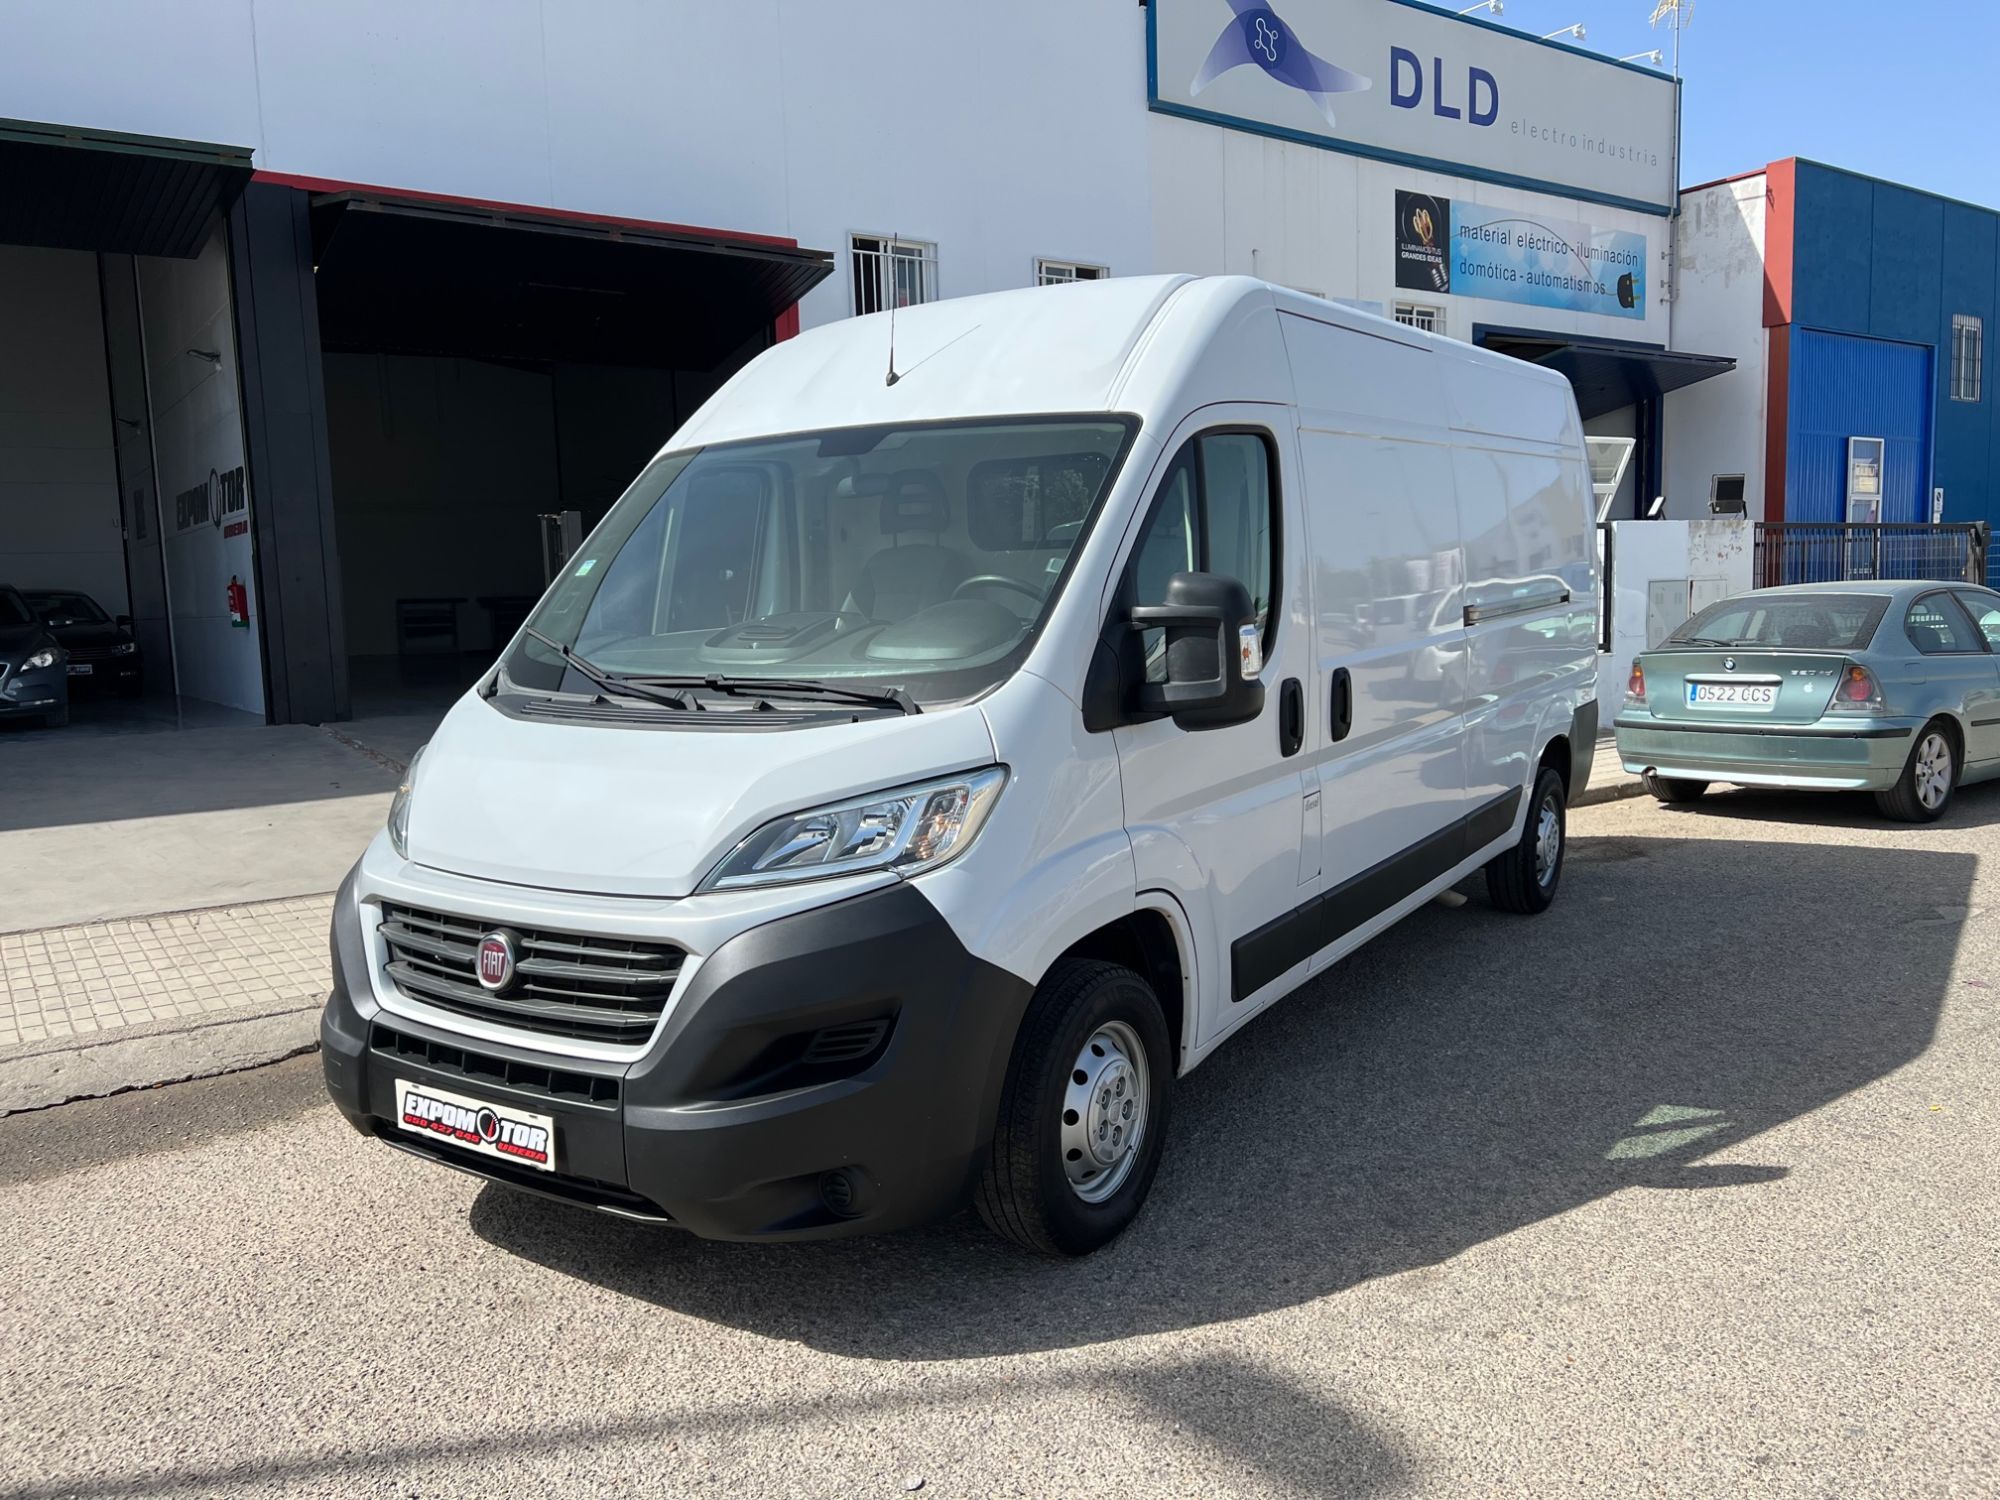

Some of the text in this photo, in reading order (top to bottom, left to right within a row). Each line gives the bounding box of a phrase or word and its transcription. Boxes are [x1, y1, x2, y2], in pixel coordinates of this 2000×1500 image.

[1390, 45, 1499, 127] DLD
[1459, 225, 1511, 246] material
[1517, 232, 1568, 255] eléctrico
[1401, 250, 1426, 262] GRANDES
[1459, 258, 1517, 282] domótica
[1526, 271, 1606, 296] automatismos
[1698, 686, 1736, 702] 0522
[483, 949, 505, 977] FIAT
